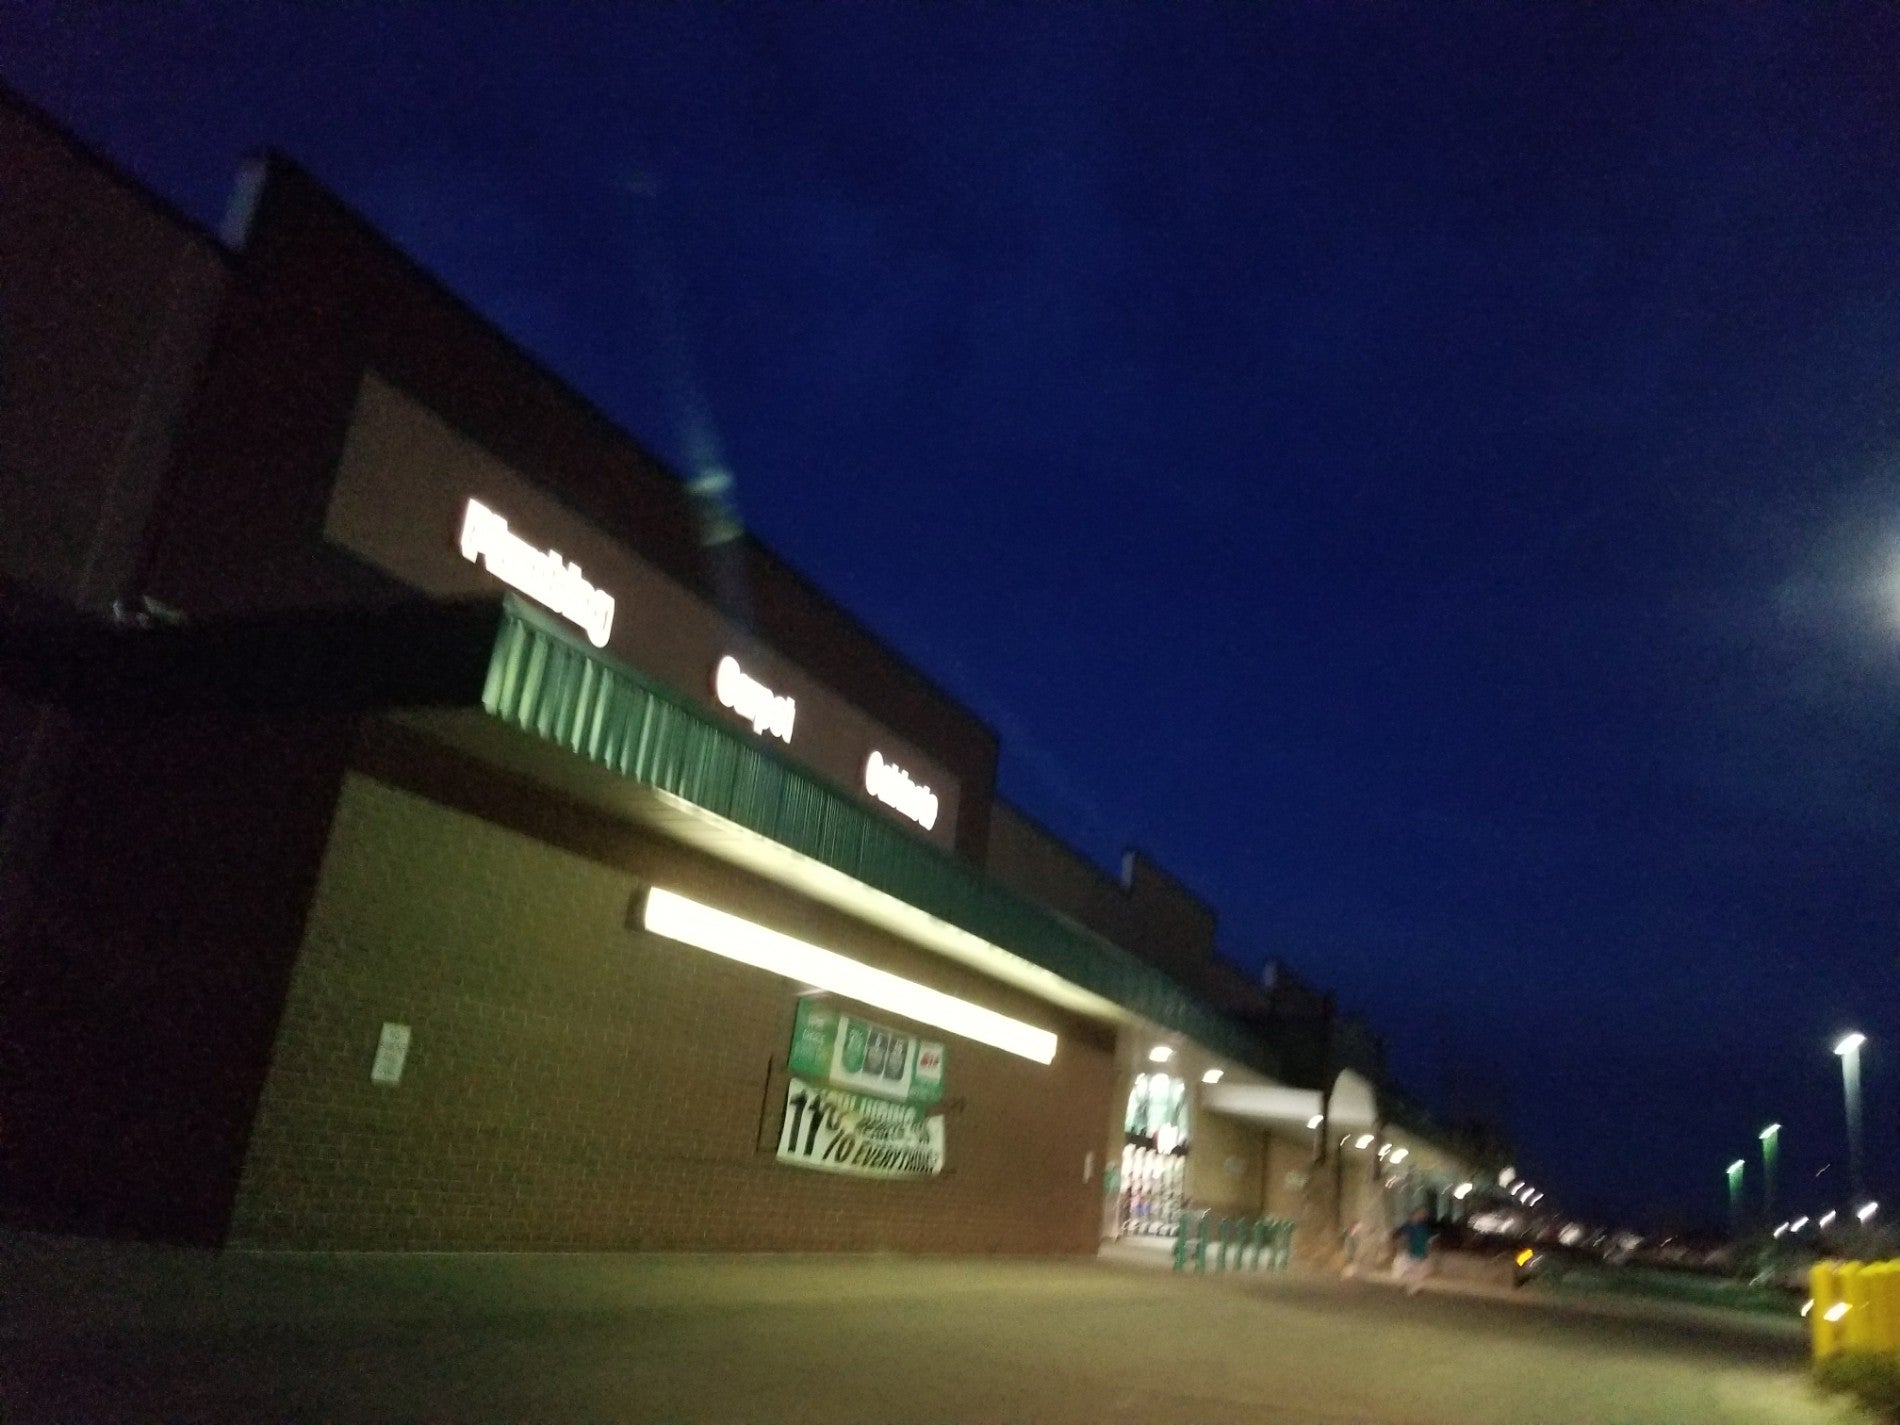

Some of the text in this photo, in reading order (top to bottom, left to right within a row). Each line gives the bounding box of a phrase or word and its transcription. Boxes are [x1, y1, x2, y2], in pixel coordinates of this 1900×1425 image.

[461, 498, 615, 648] Plumbing
[716, 656, 796, 744] Carpet
[865, 751, 938, 831] Cabinets
